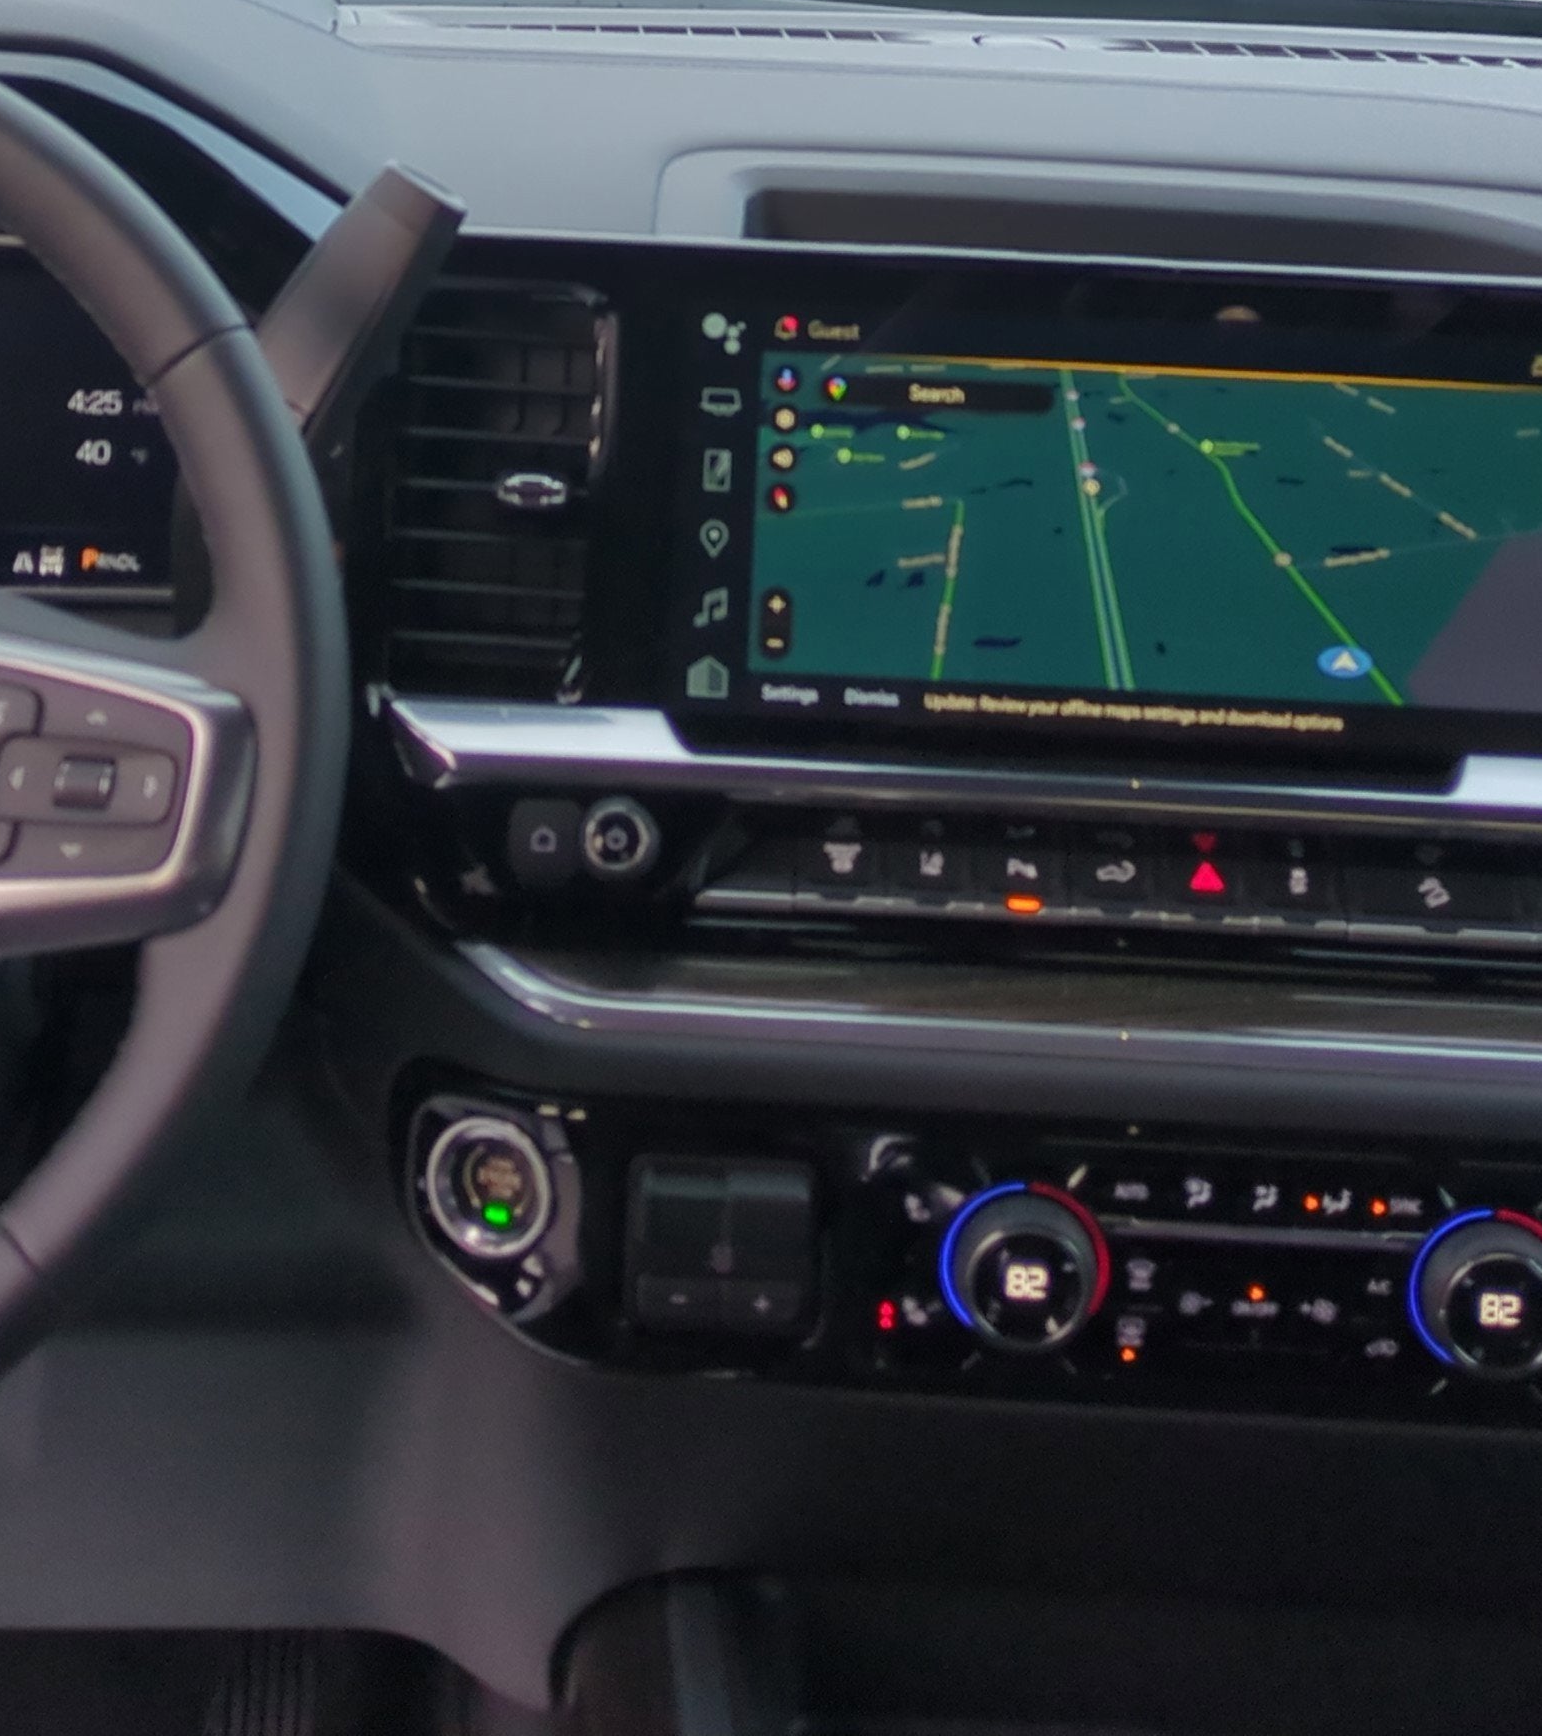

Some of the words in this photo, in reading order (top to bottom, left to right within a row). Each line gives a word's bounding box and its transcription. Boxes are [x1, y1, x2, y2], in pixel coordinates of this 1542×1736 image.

[66, 388, 124, 416] 4:25
[908, 383, 966, 404] Search
[75, 438, 112, 466] 40
[761, 682, 820, 706] Settings
[1004, 1263, 1050, 1302] 82
[1478, 1293, 1523, 1329] 82
